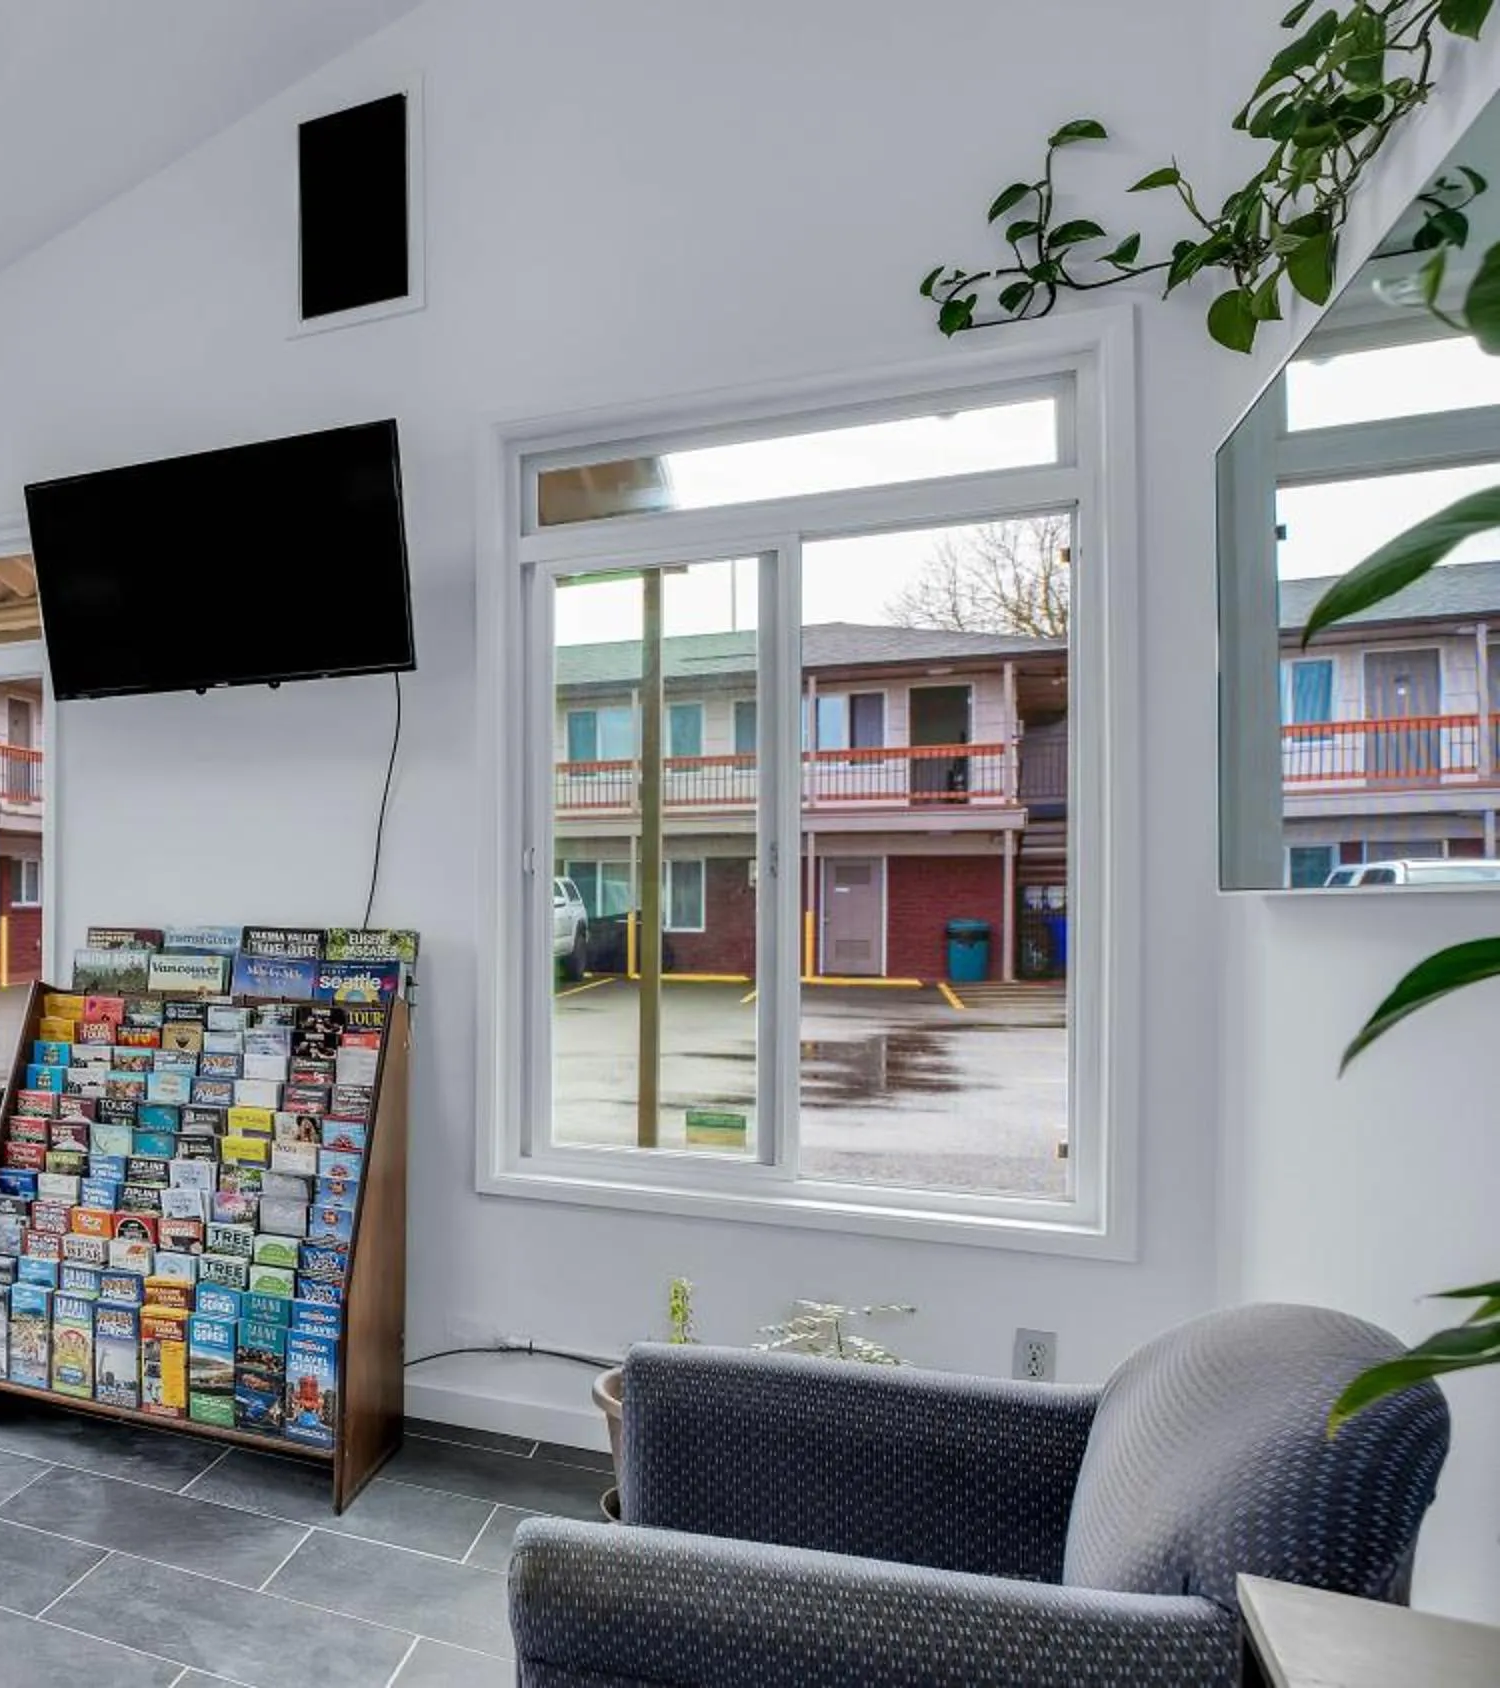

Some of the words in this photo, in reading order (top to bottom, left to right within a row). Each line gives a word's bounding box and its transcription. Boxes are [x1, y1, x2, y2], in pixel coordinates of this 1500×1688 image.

[287, 932, 319, 943] VALLEY
[349, 933, 390, 945] EUGENE
[287, 944, 317, 957] GUIDE
[152, 962, 220, 975] Vancouver
[320, 971, 381, 989] seattle
[100, 1099, 135, 1112] TOURS
[214, 1229, 251, 1247] TREE
[206, 1261, 243, 1277] TREE
[290, 1352, 327, 1364] TRAVEL
